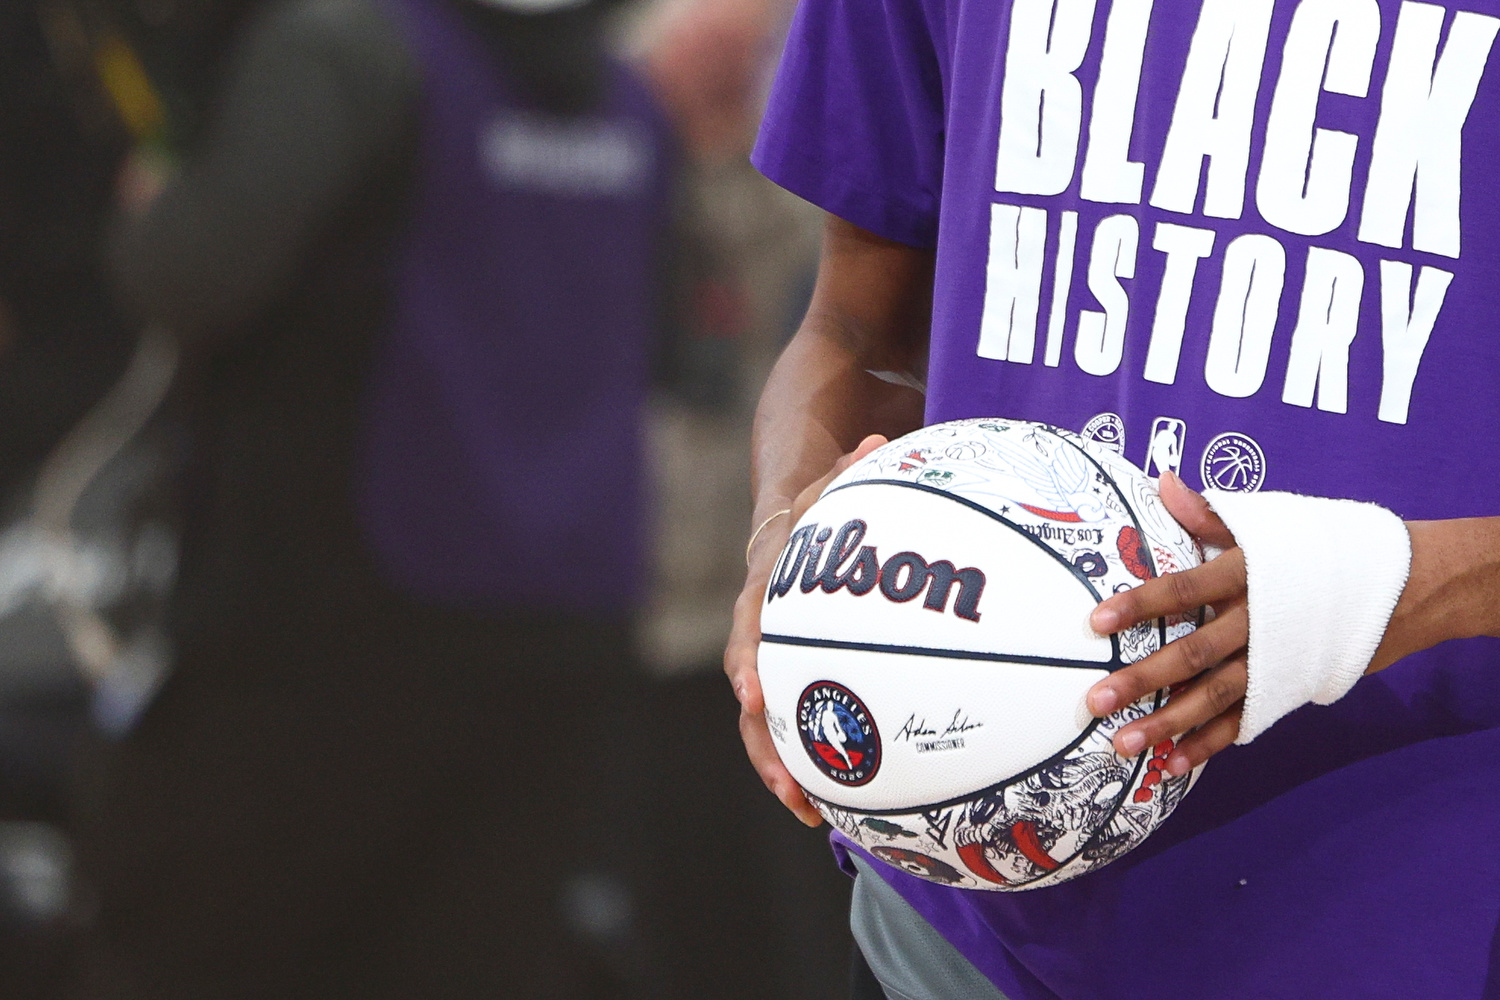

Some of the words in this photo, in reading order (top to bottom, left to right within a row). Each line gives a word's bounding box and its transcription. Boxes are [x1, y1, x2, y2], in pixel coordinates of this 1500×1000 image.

[976, 202, 1455, 425] HISTORY
[1076, 528, 1105, 546] Los
[767, 518, 987, 624] Wilson
[800, 700, 812, 731] LOS
[813, 687, 873, 736] ANGELES
[915, 738, 966, 754] COMMISSIONER
